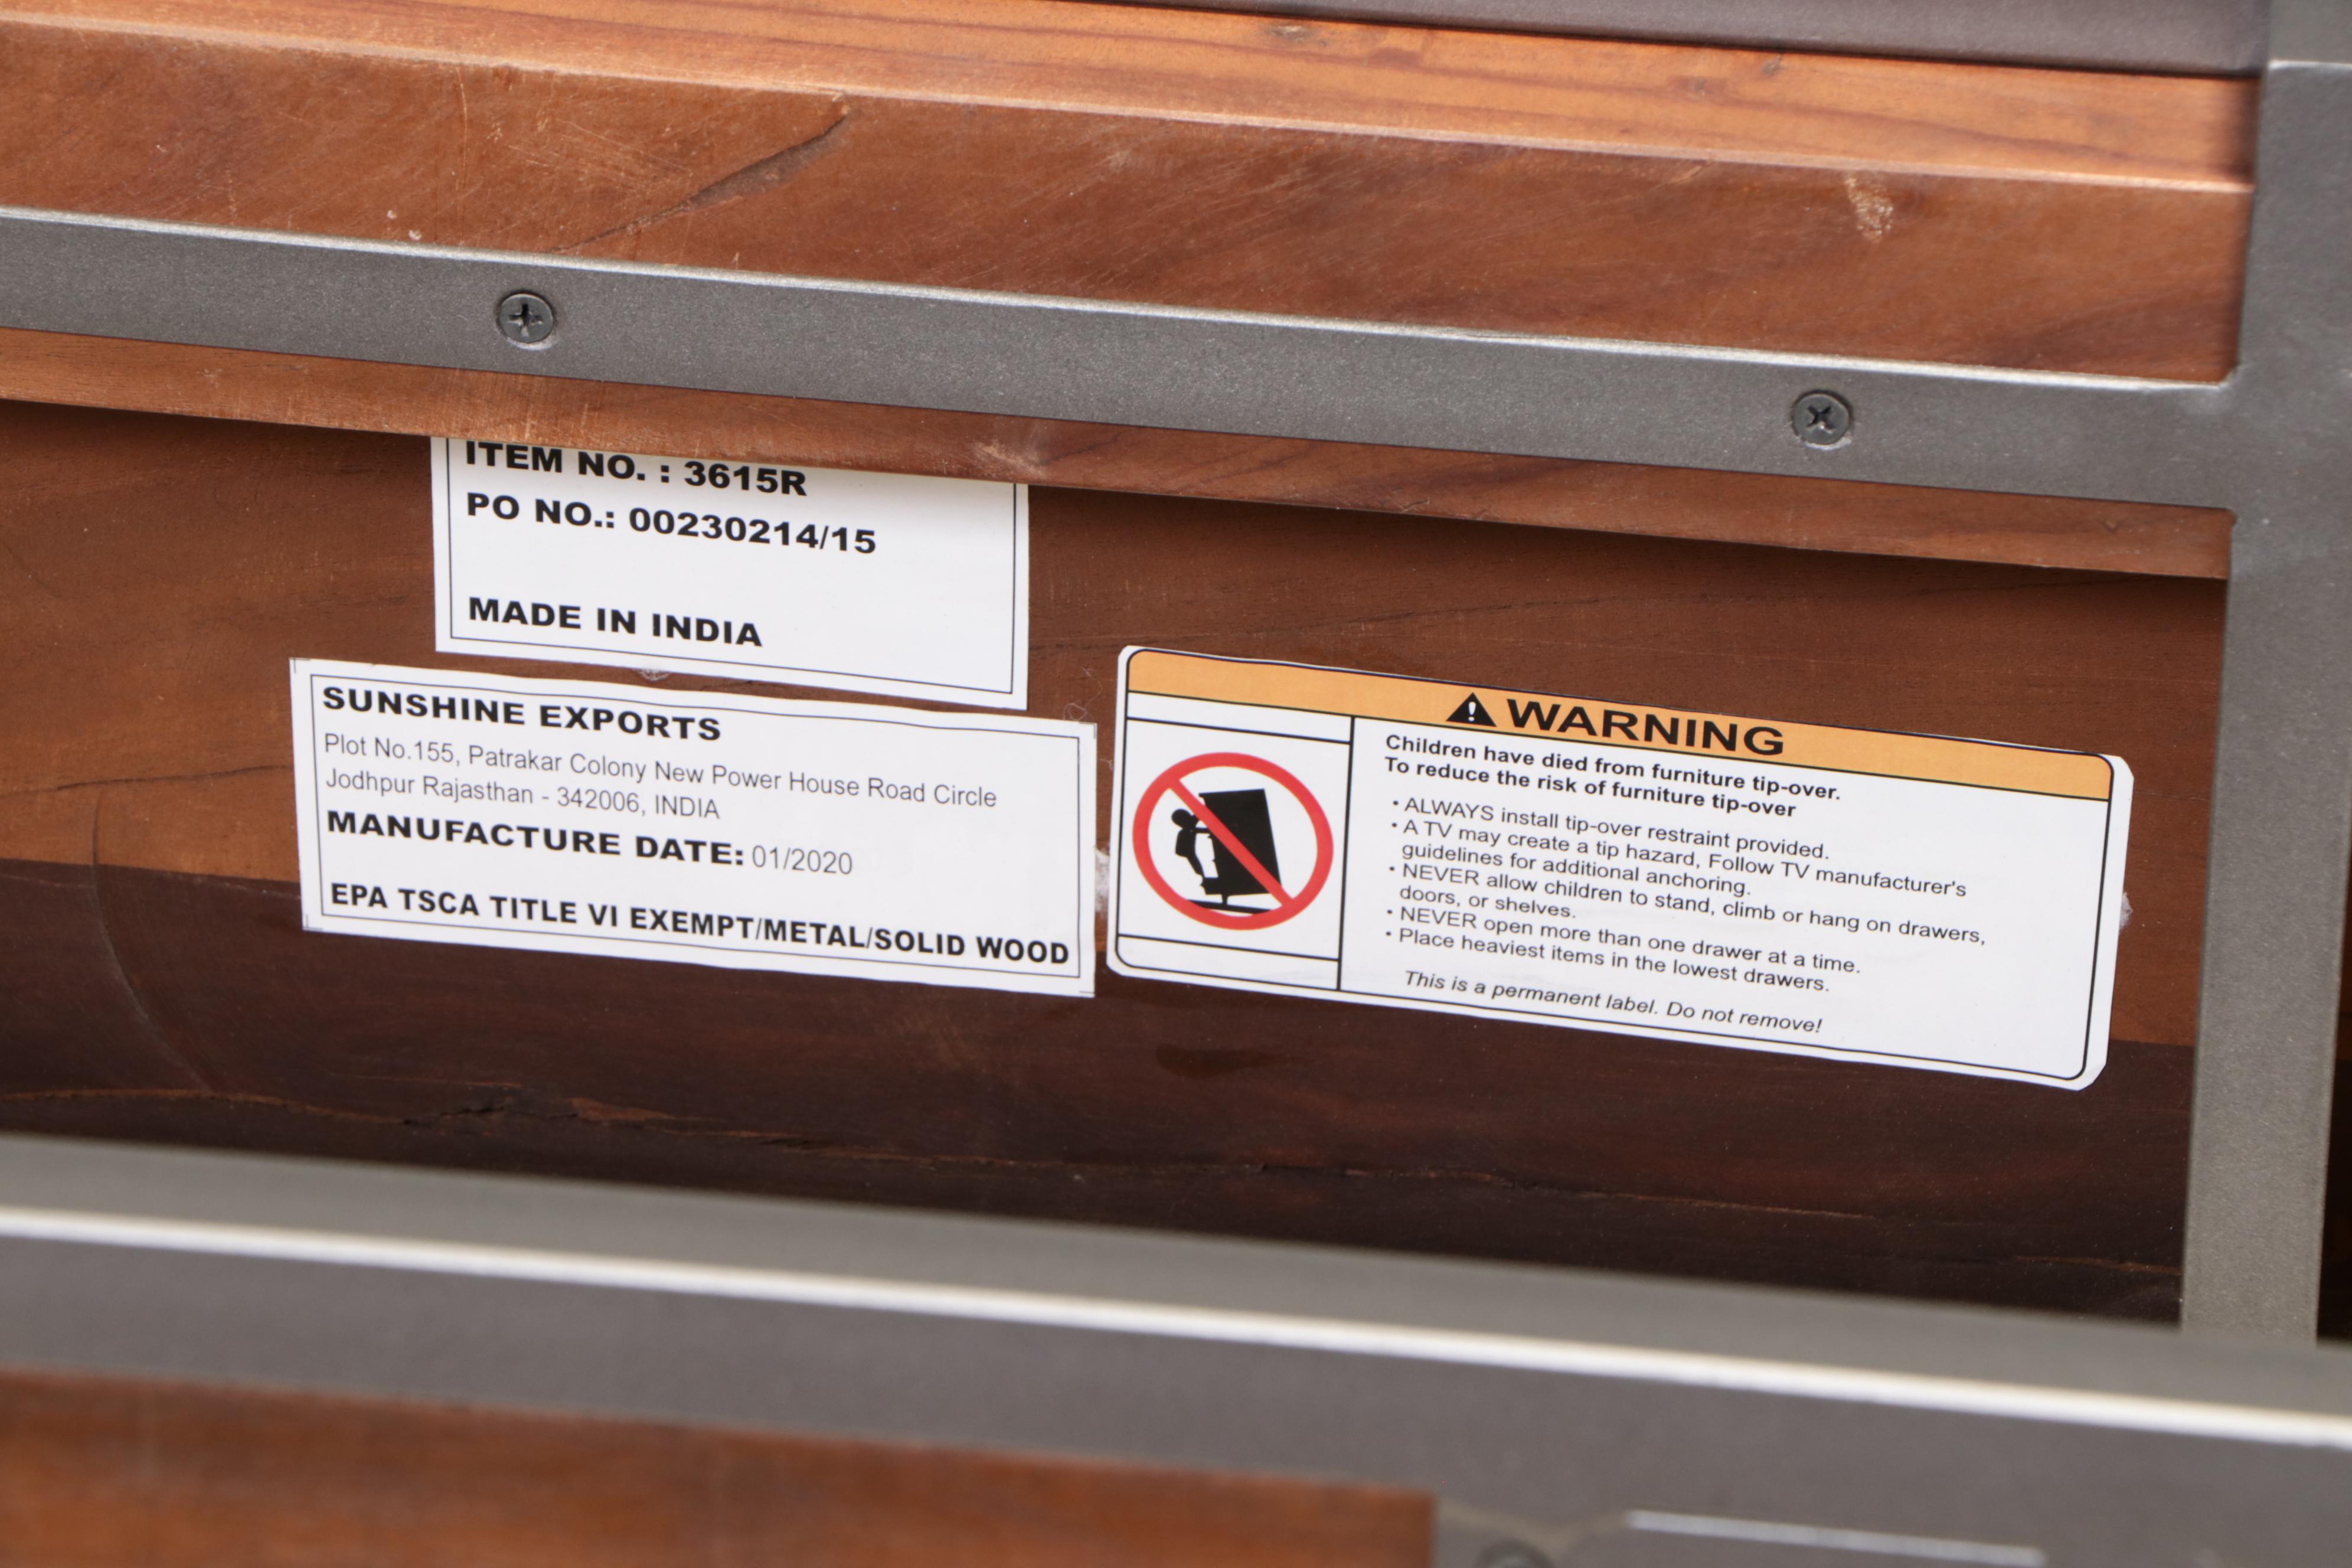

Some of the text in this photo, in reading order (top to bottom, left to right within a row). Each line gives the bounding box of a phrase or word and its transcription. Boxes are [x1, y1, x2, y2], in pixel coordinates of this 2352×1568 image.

[466, 439, 563, 473] ITEM
[578, 451, 646, 481] NO.
[684, 460, 807, 496] 3615R
[466, 491, 877, 554] PO NO.: 00230214/15
[469, 596, 763, 648] MADE IN INDIA
[322, 685, 721, 741] SUNSHINE EXPORTS
[1506, 698, 1784, 756] WARNING
[325, 733, 997, 808] Plot No.155, Patrakar Colony New Power House Road Circle
[326, 768, 415, 797] Jodhpur
[423, 775, 533, 803] Rajasthan
[557, 786, 645, 816] 342006,
[655, 795, 720, 819] INDIA
[1384, 756, 1797, 817] To reduce the risk of furniture tip-over
[1386, 734, 1840, 800] Children have died from furniture tip-over.
[327, 809, 852, 875] MANUFACTURE DATE: 01/2020
[1403, 819, 1966, 897] A TV may create a tip hazard, Follow TV manufacturer's
[1404, 797, 1829, 860] ALWAYS install tip-over restraint provided.
[1399, 885, 1576, 919] doors, or shelves.
[1402, 843, 1750, 898] guidelines for additional anchoring.
[331, 882, 1069, 965] EPA TSCA TITLE VI EXEMPT/METAL/SOLID WOOD
[1403, 863, 1985, 946] NEVER allow children to stand, climb or hang on drawers,
[1399, 927, 1829, 992] Place heaviest items in the lowest drawers.
[1400, 906, 1860, 974] NEVER open more than one drawer at a time.
[1406, 971, 1823, 1033] This is a permanent label. Do not remove!
